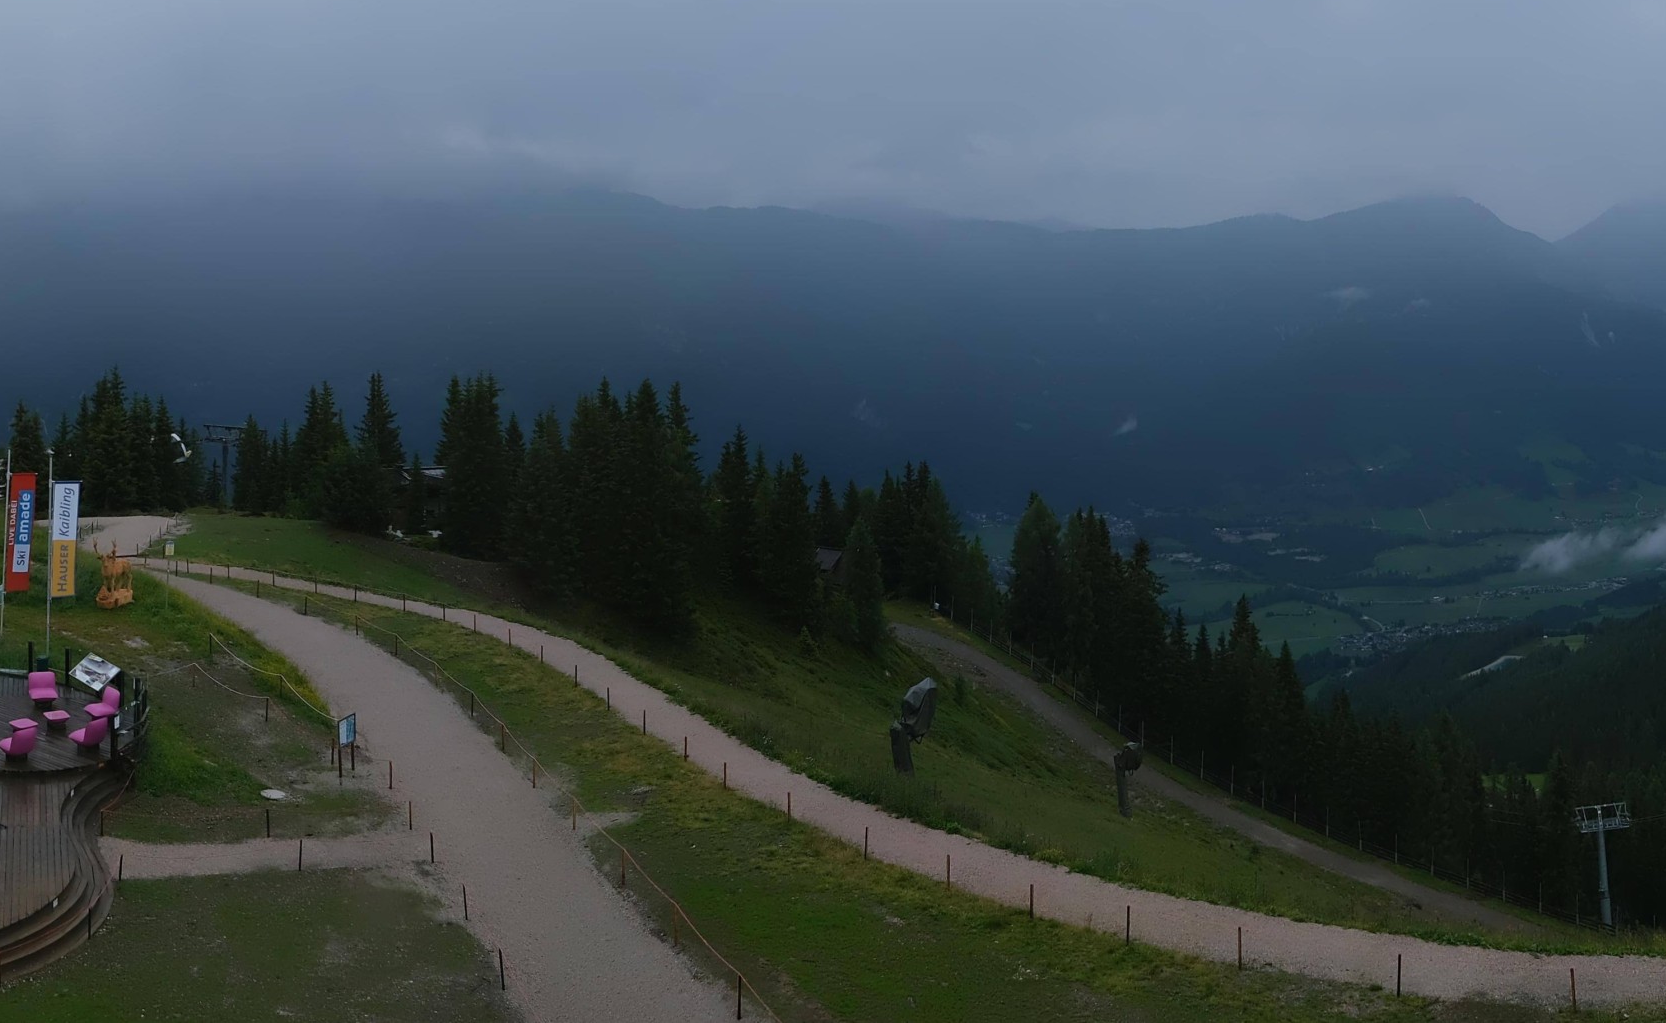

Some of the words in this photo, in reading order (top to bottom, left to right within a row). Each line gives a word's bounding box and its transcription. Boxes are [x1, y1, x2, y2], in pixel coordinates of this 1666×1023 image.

[10, 500, 18, 526] DABEI
[58, 487, 75, 537] Kaibling
[8, 526, 16, 546] LIVE
[16, 550, 27, 566] Ski
[57, 544, 69, 592] HAUSER
